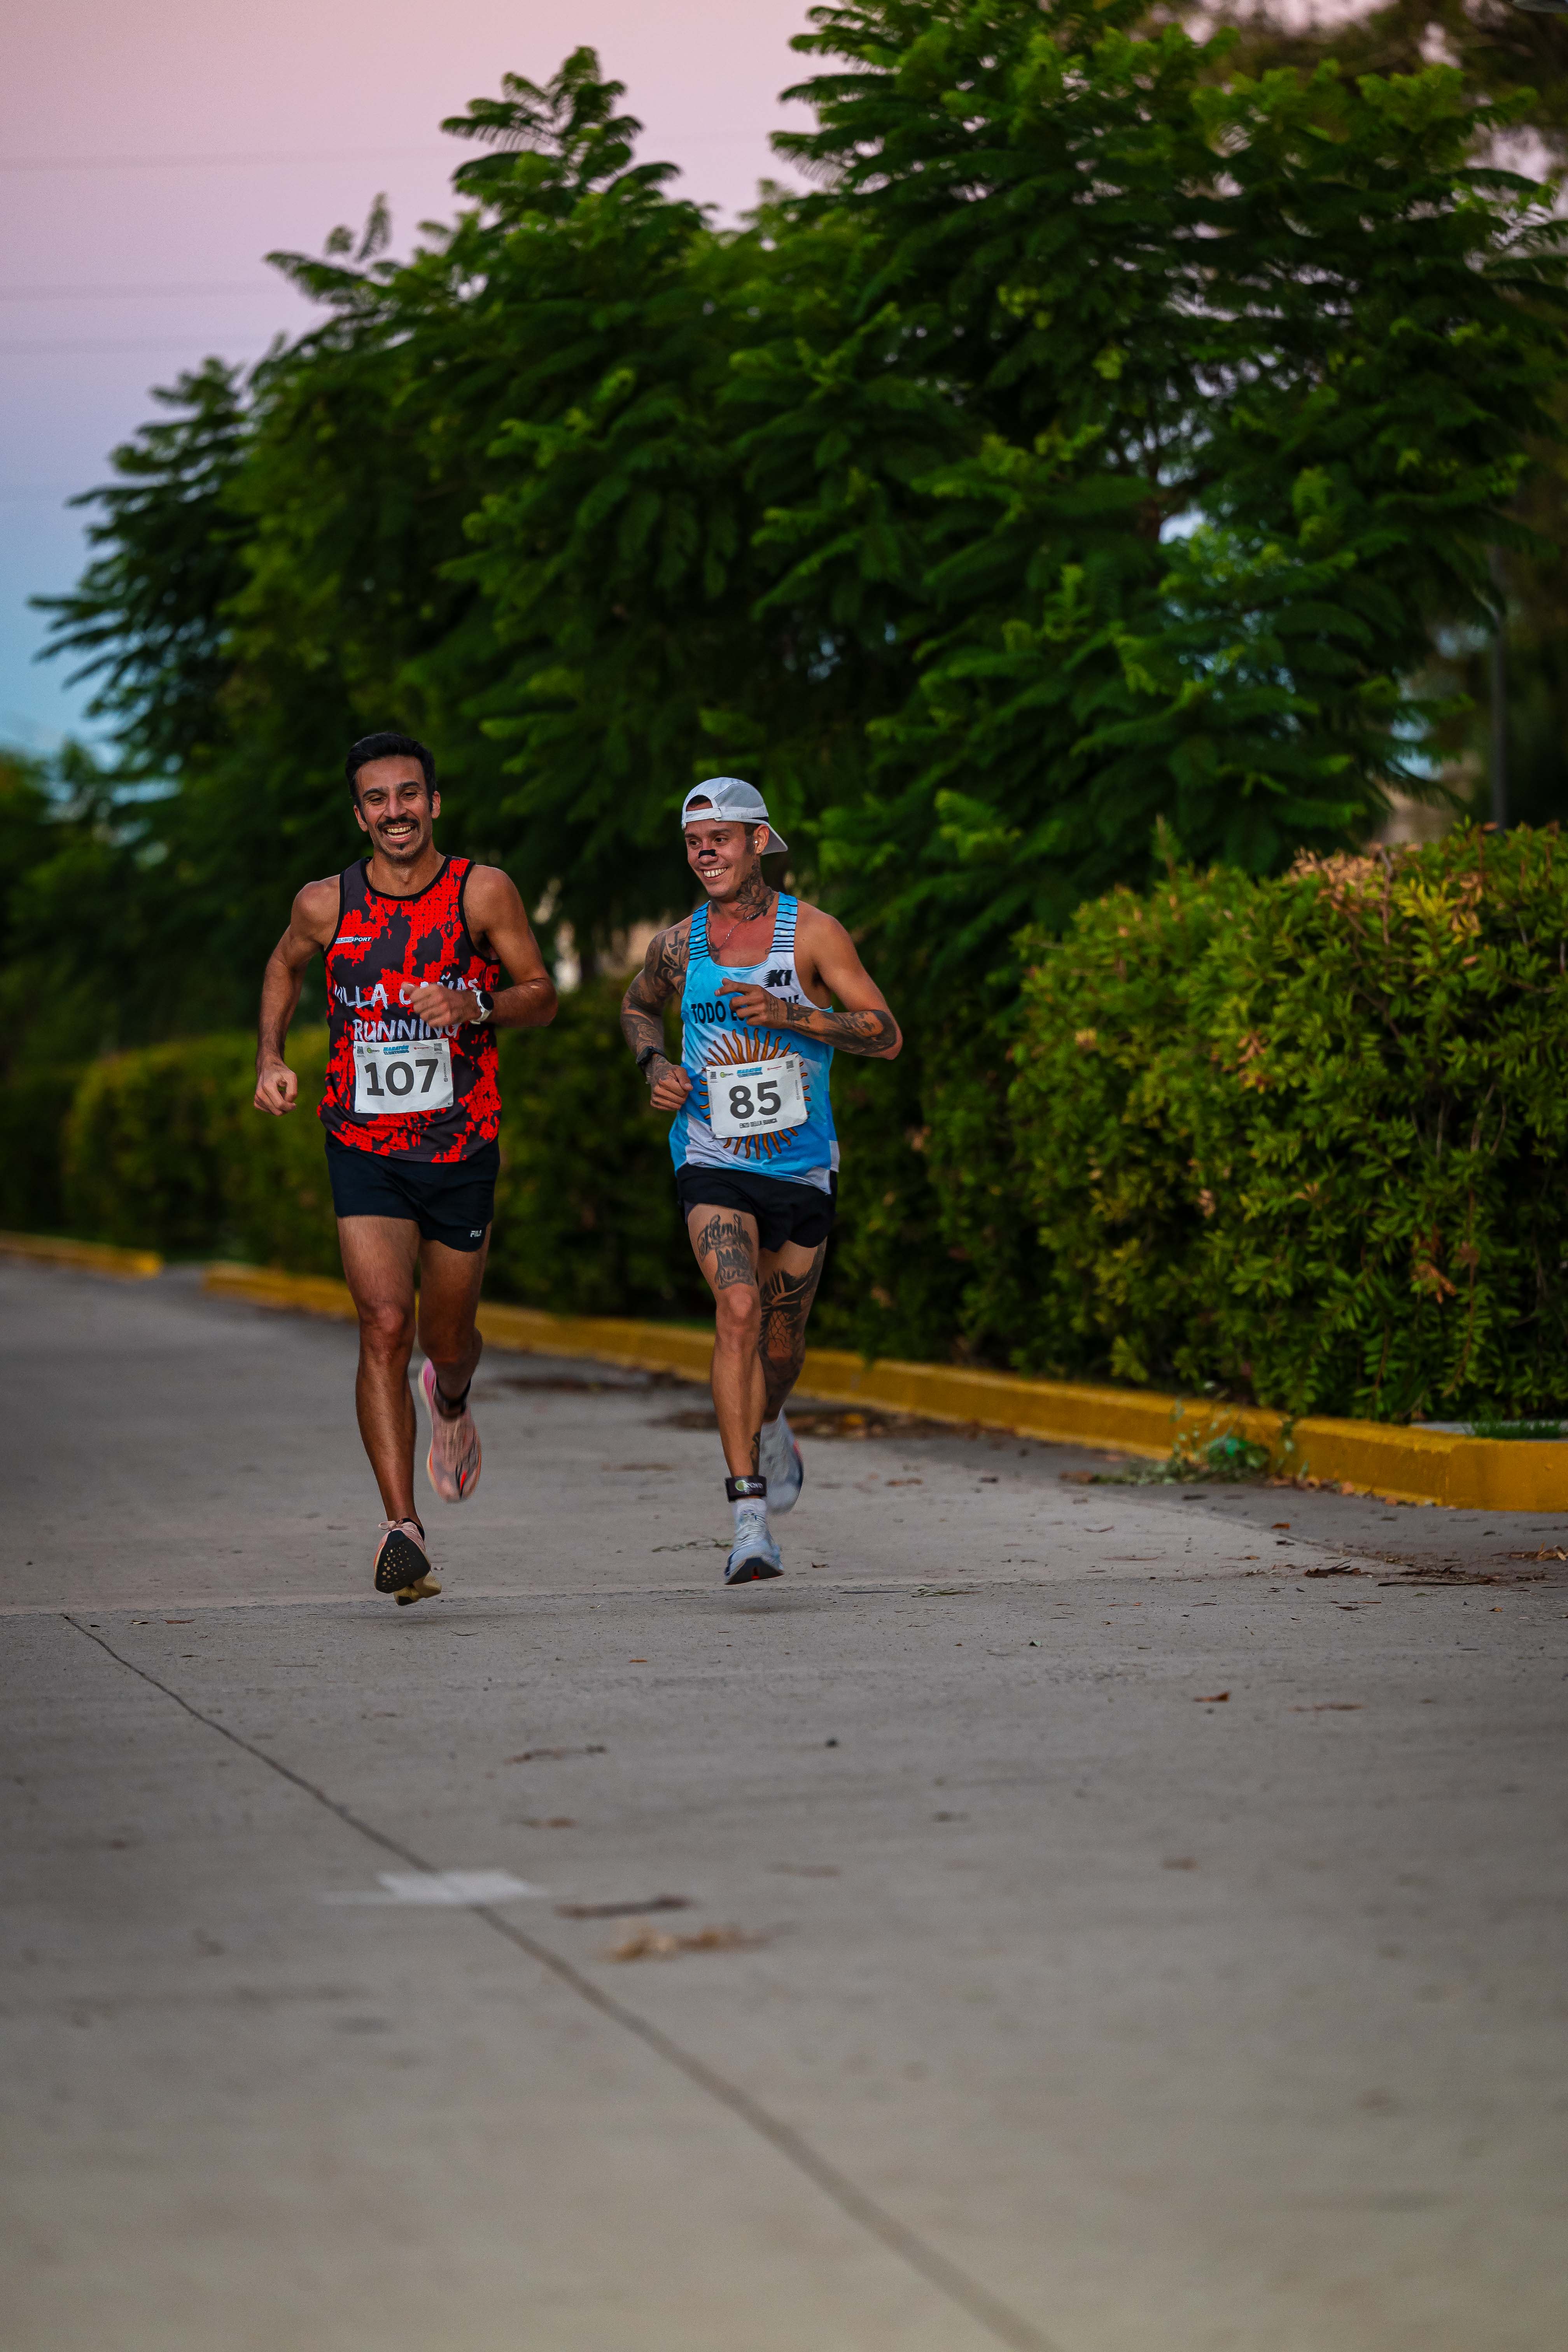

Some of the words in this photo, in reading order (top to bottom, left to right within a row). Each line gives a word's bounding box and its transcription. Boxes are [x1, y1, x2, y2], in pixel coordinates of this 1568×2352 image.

[691, 1000, 726, 1024] TODO
[352, 1018, 462, 1043] RUNNING
[364, 1058, 439, 1096] 107
[729, 1080, 781, 1119] 85
